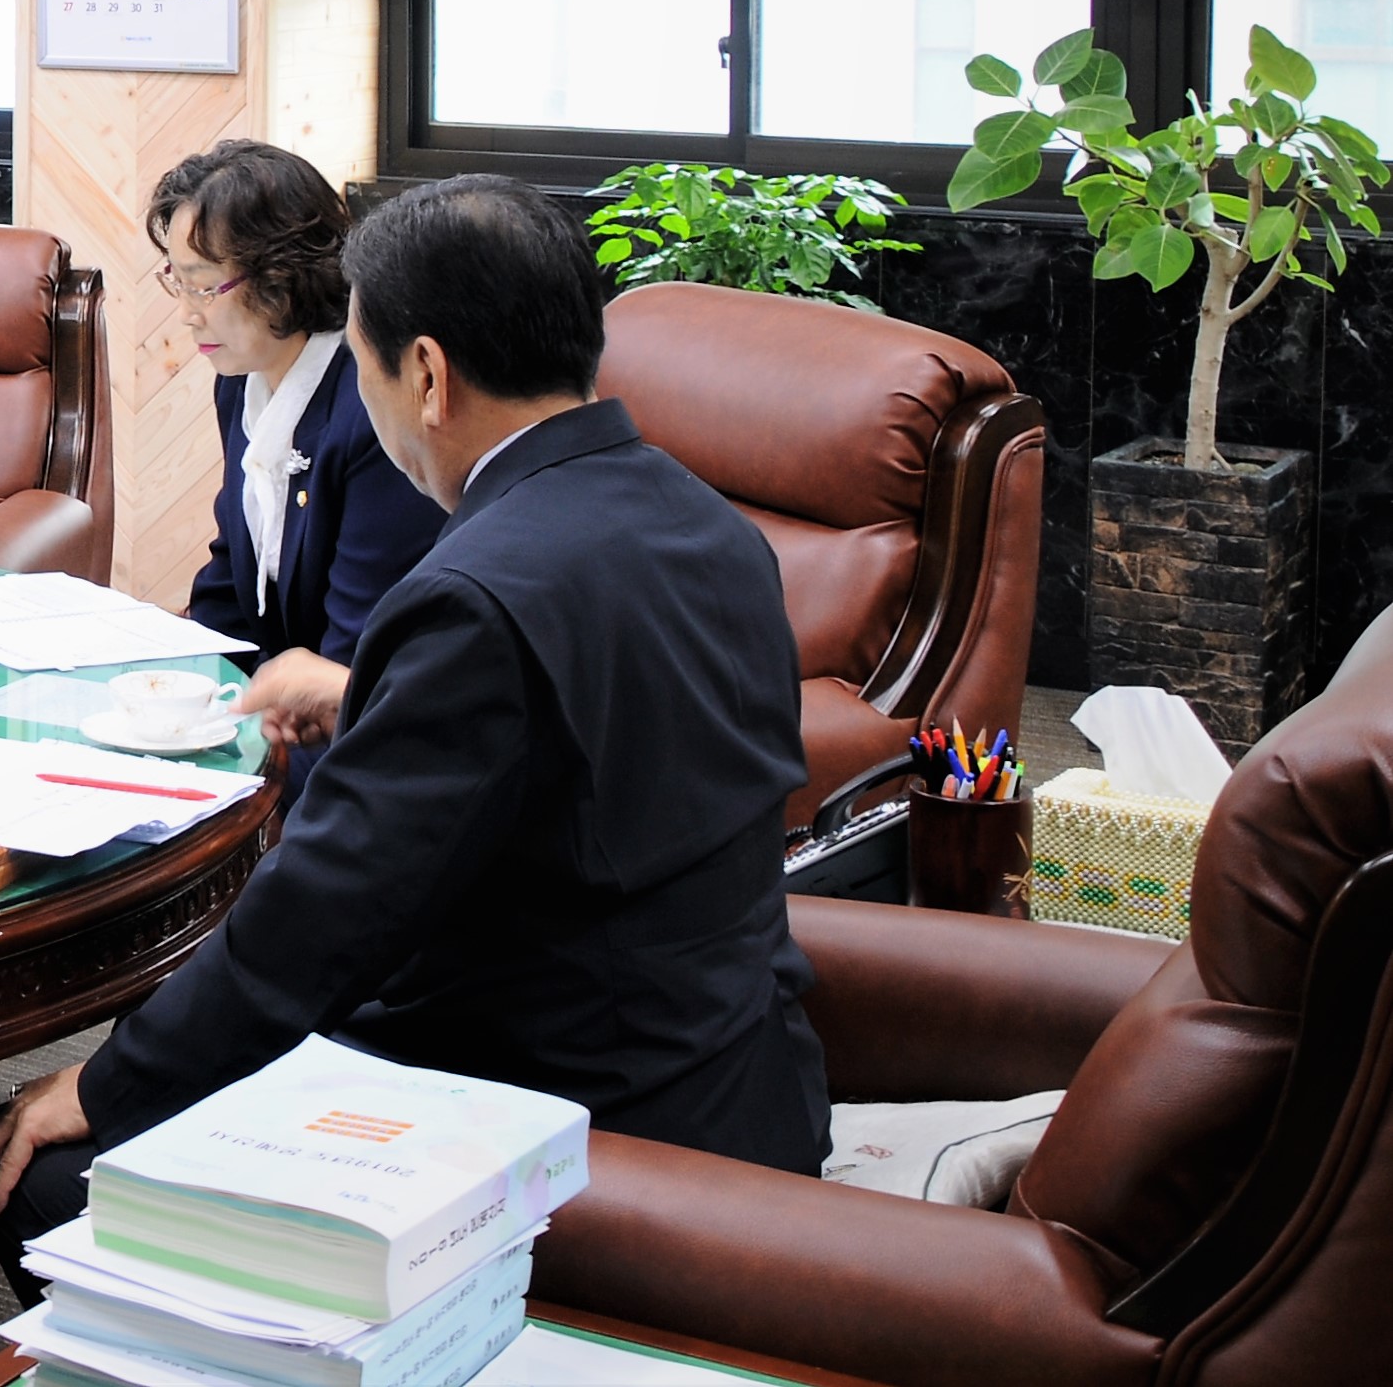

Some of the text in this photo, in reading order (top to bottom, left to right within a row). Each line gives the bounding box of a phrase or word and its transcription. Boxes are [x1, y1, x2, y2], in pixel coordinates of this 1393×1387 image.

[64, 2, 162, 12] 27 28 29 30 31
